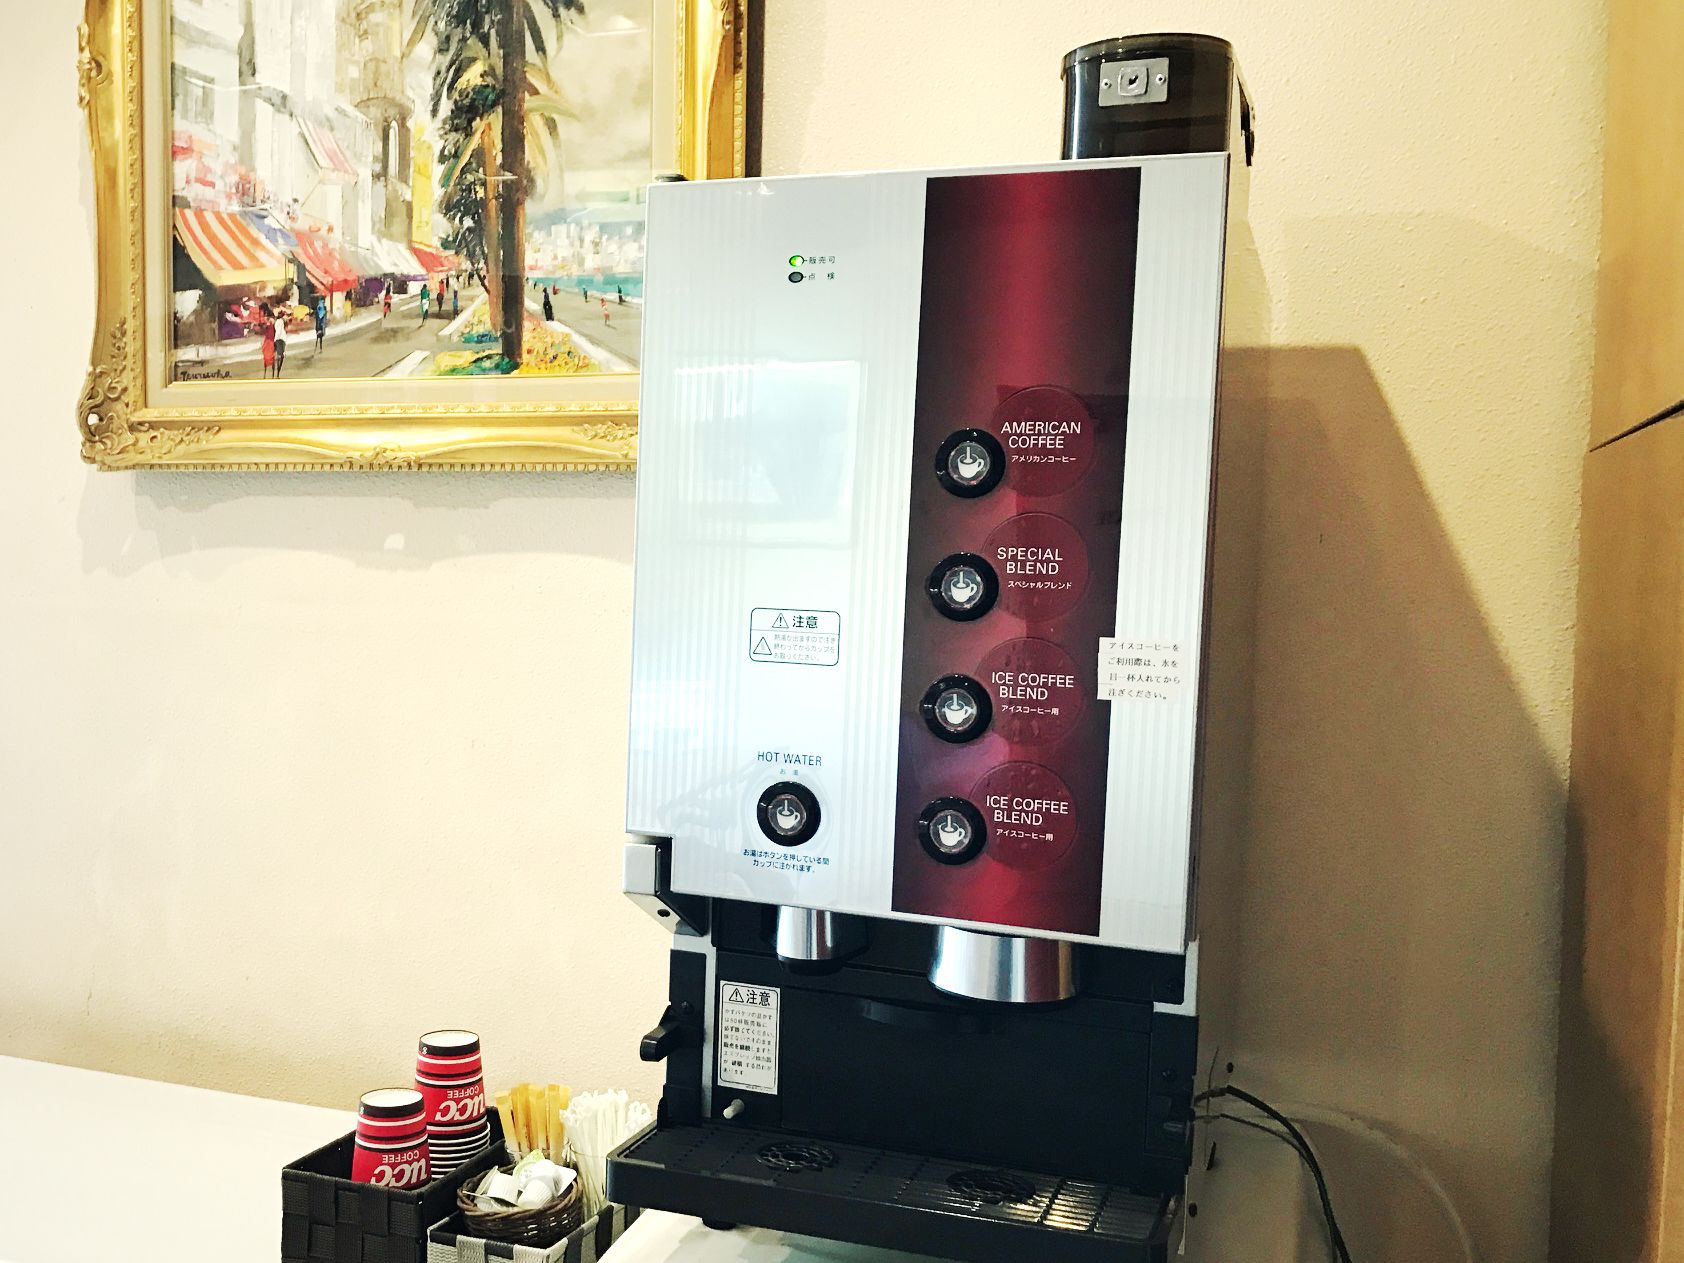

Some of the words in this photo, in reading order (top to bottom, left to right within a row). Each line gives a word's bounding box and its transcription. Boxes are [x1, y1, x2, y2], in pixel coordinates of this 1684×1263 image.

[1000, 421, 1082, 435] AMERICAN
[1008, 435, 1065, 449] COFFEE
[1011, 454, 1077, 464] アメリカンコーヒー
[997, 547, 1064, 561] SPECIAL
[1006, 561, 1060, 575] BLEND
[1007, 580, 1073, 590] スペシャルブレンド
[792, 615, 818, 629] 注意
[1109, 642, 1180, 652] アイスコーヒーを
[992, 671, 1014, 684] ICE
[1018, 673, 1075, 688] COFFEE
[1000, 686, 1048, 700] BLEND
[1001, 704, 1059, 716] アイスコーヒー用
[757, 751, 780, 762] HOT
[783, 753, 822, 767] WATER
[986, 795, 1008, 808] ICE
[1012, 797, 1069, 815] COFFEE
[994, 810, 1043, 825] BLEND
[996, 828, 1054, 842] アイスコーヒー用
[746, 989, 771, 1007] 注意
[447, 1085, 480, 1099] COFFEE
[381, 1149, 420, 1163] COFFEE
